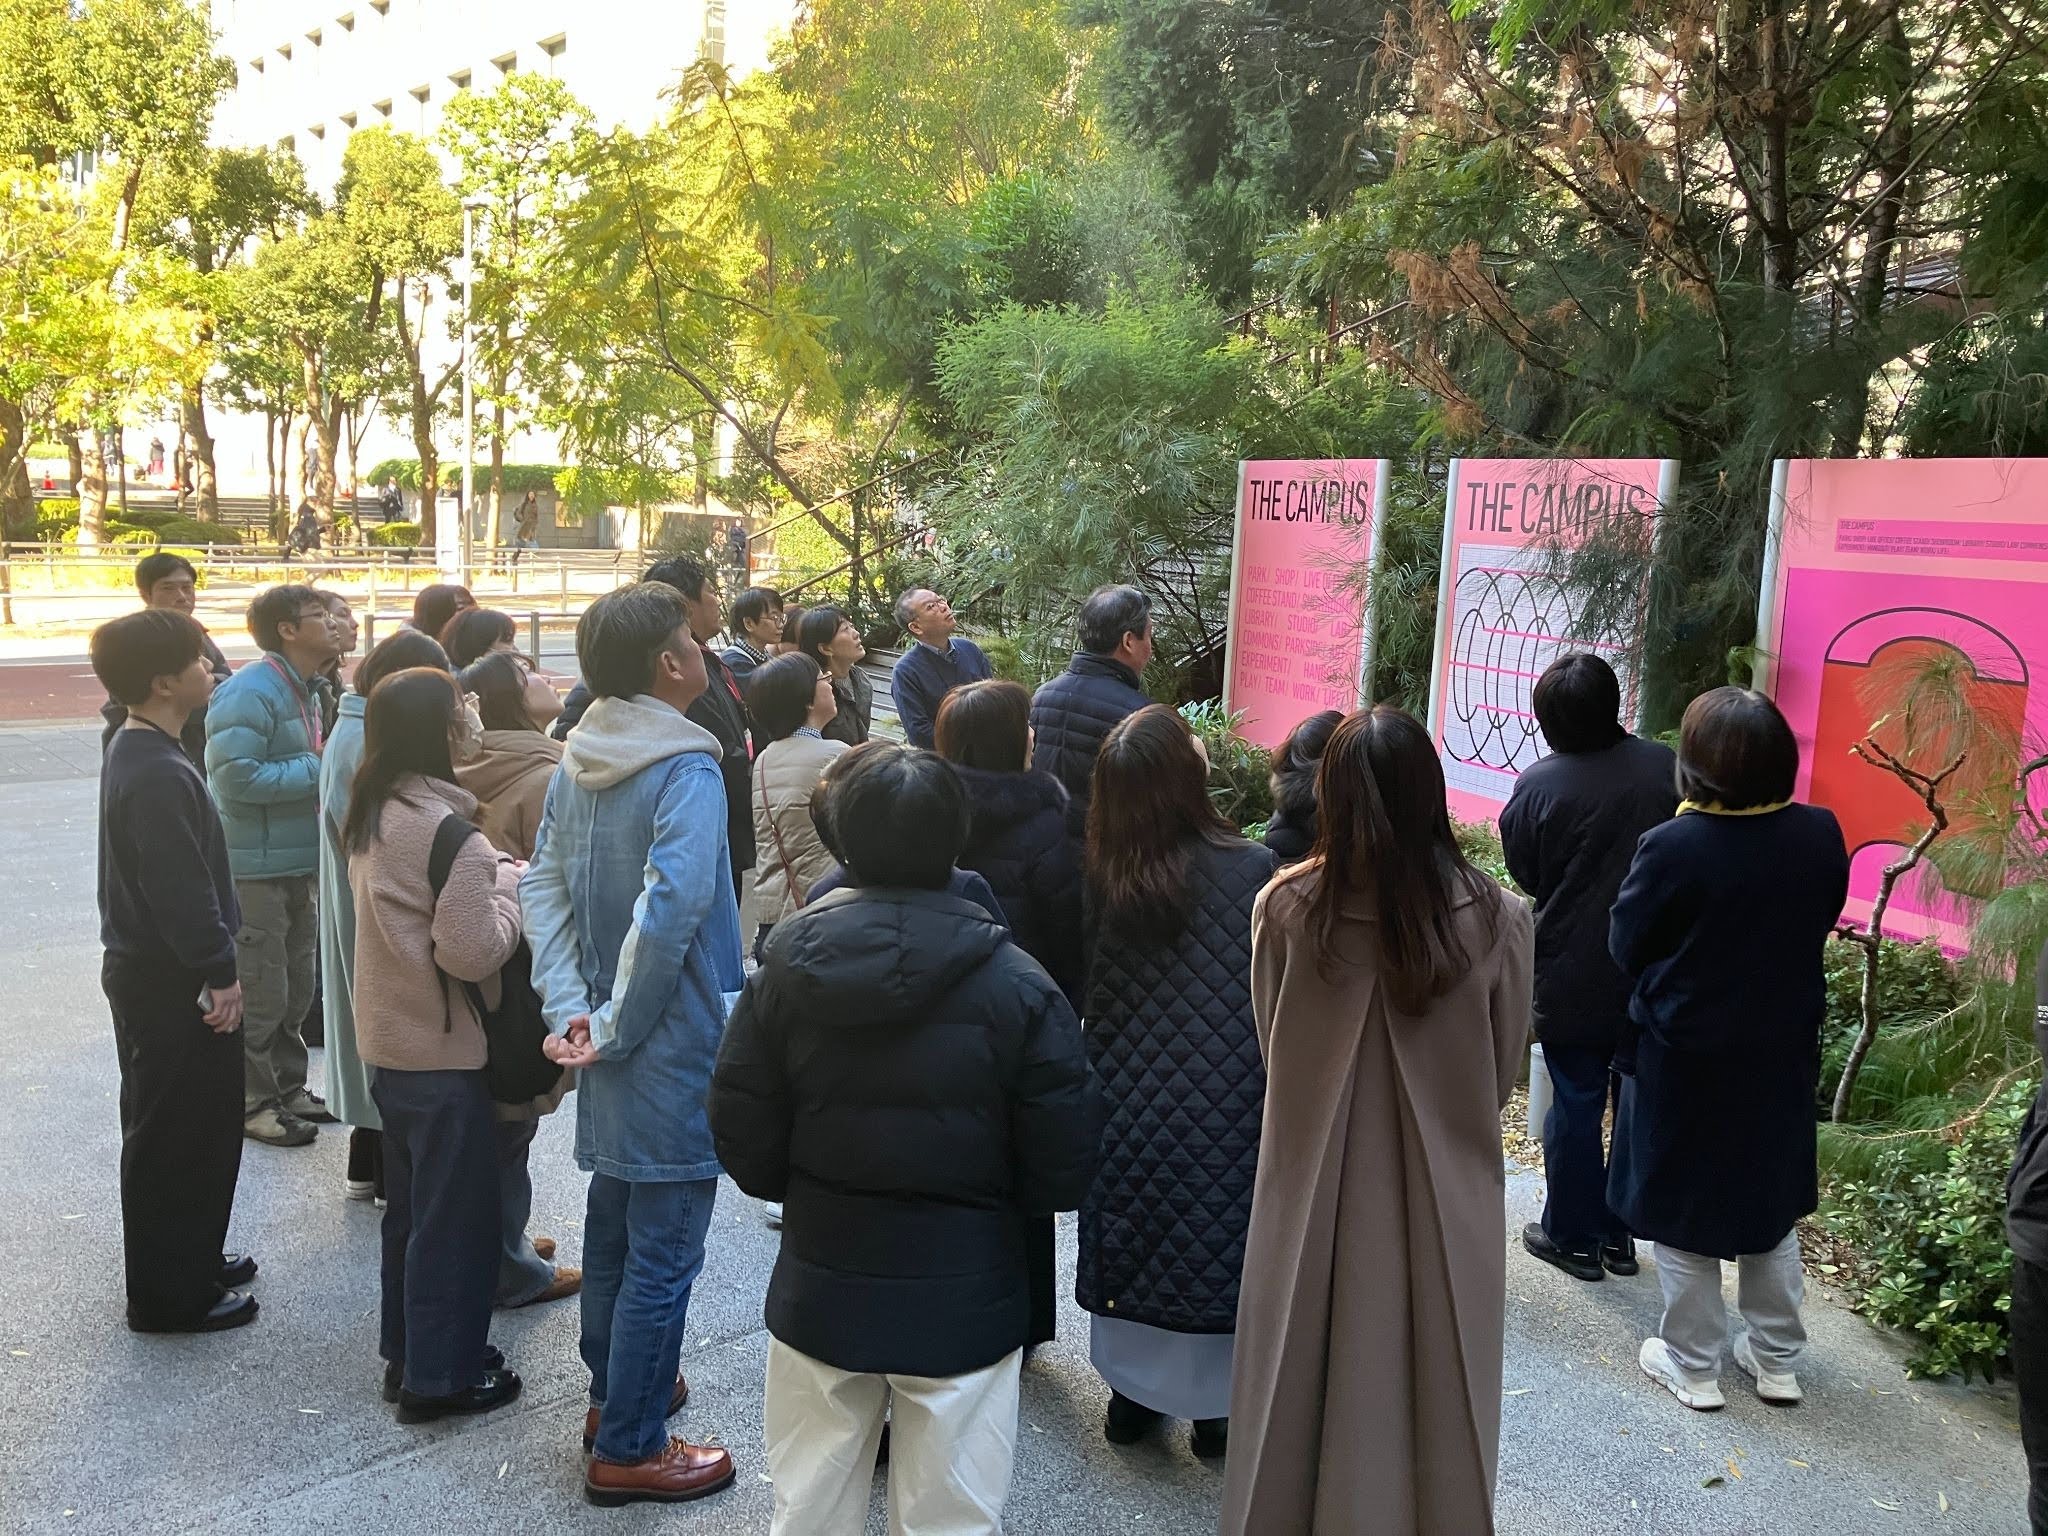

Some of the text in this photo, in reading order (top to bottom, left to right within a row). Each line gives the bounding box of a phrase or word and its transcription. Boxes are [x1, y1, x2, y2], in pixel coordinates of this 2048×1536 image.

[1250, 480, 1369, 525] THE CAMPUS
[1467, 482, 1646, 538] THE CAMPUS
[1275, 568, 1299, 587] SHOP/
[1303, 570, 1321, 588] LIVE
[1241, 650, 1292, 677] EXPERIMENT/
[1240, 671, 1262, 689] PLAY/
[1265, 676, 1289, 696] TEAM/
[1292, 682, 1320, 704] WORK/
